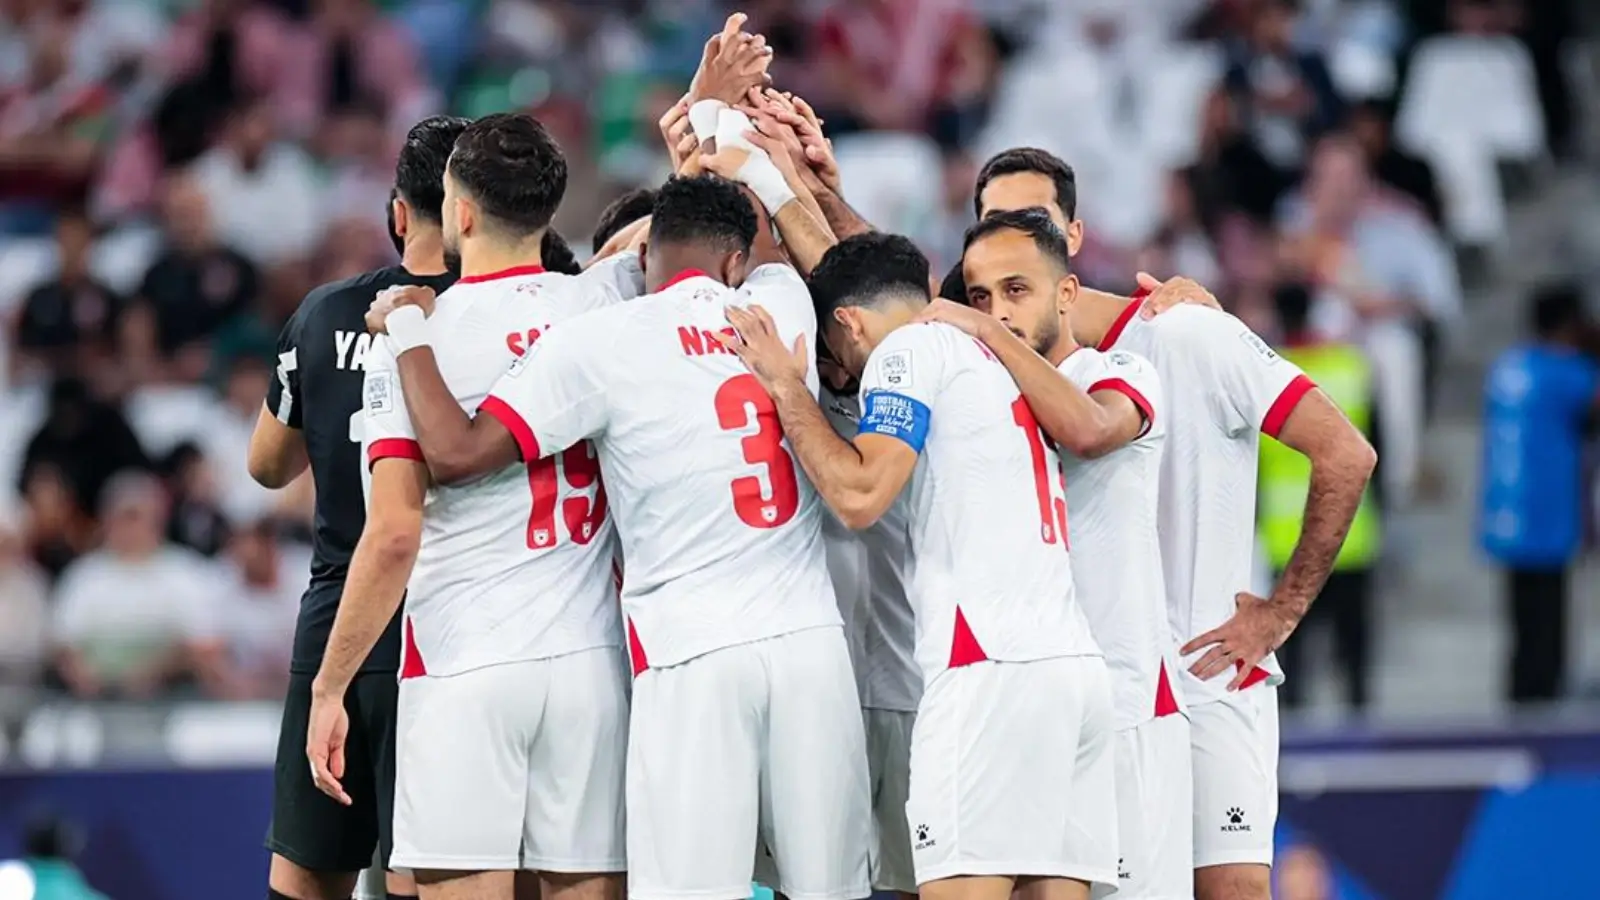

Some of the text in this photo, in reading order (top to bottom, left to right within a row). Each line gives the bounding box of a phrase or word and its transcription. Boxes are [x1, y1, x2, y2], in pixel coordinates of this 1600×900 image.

[714, 373, 799, 528] 3
[872, 404, 914, 421] UNITES
[1011, 393, 1070, 552] 1
[526, 438, 608, 549] 19
